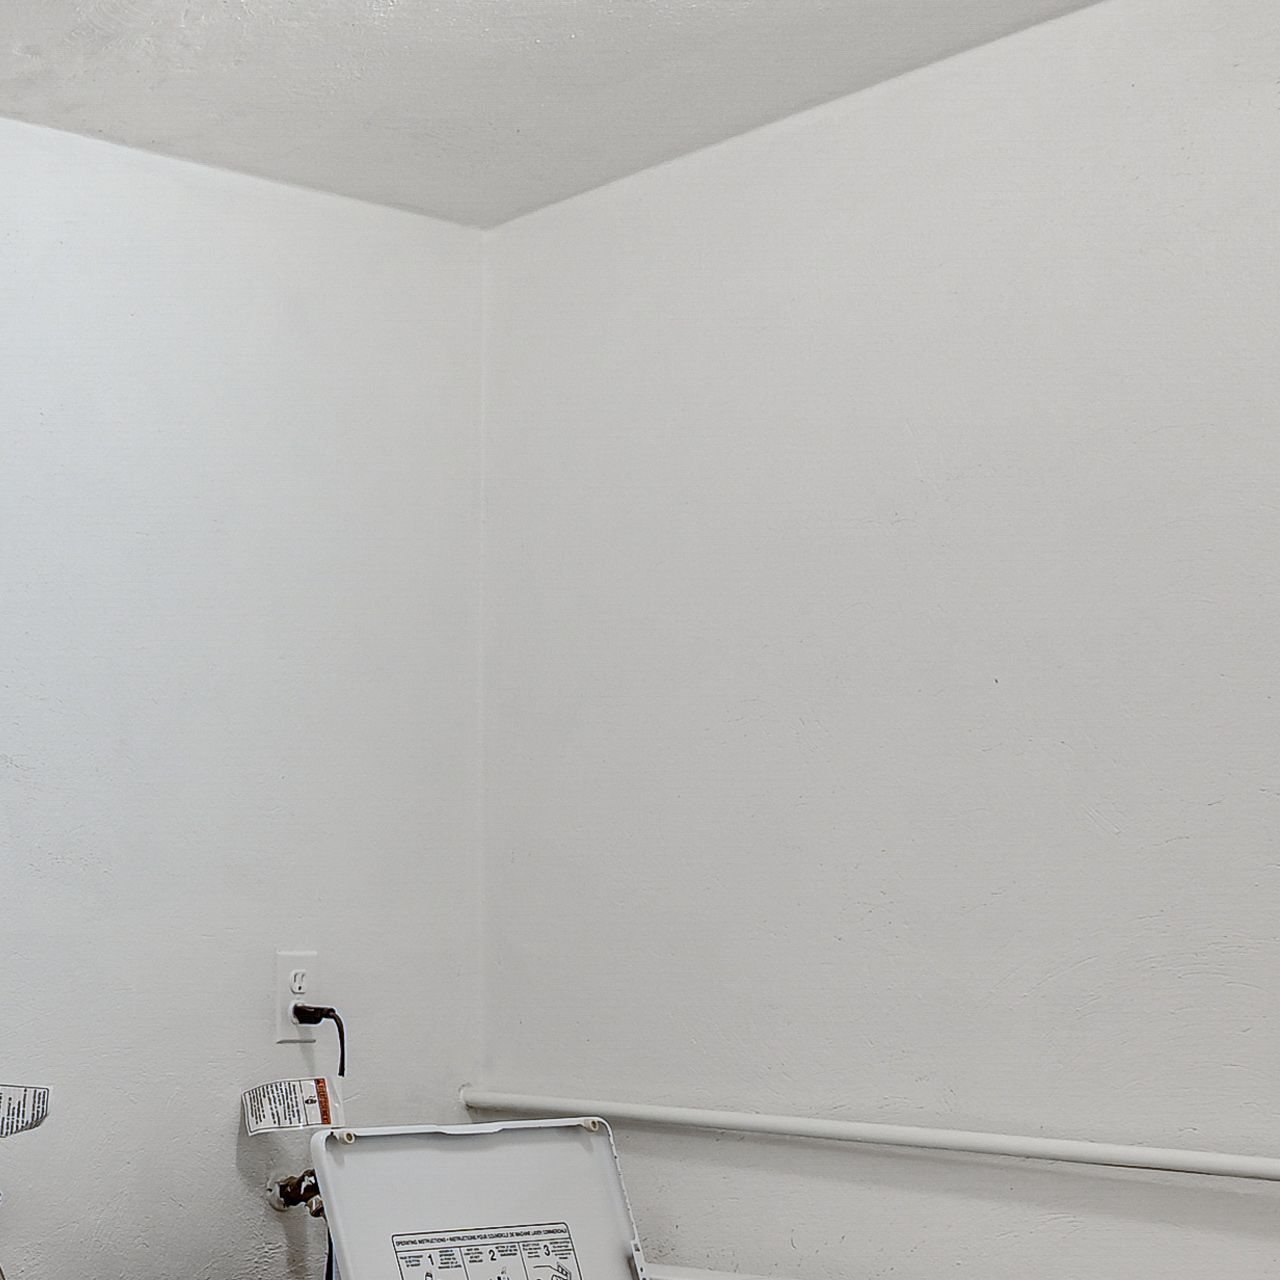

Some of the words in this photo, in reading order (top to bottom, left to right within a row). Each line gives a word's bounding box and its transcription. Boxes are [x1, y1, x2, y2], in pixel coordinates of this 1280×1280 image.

[490, 1250, 496, 1261] 2
[544, 1245, 551, 1256] 3
[428, 1254, 434, 1266] 1
